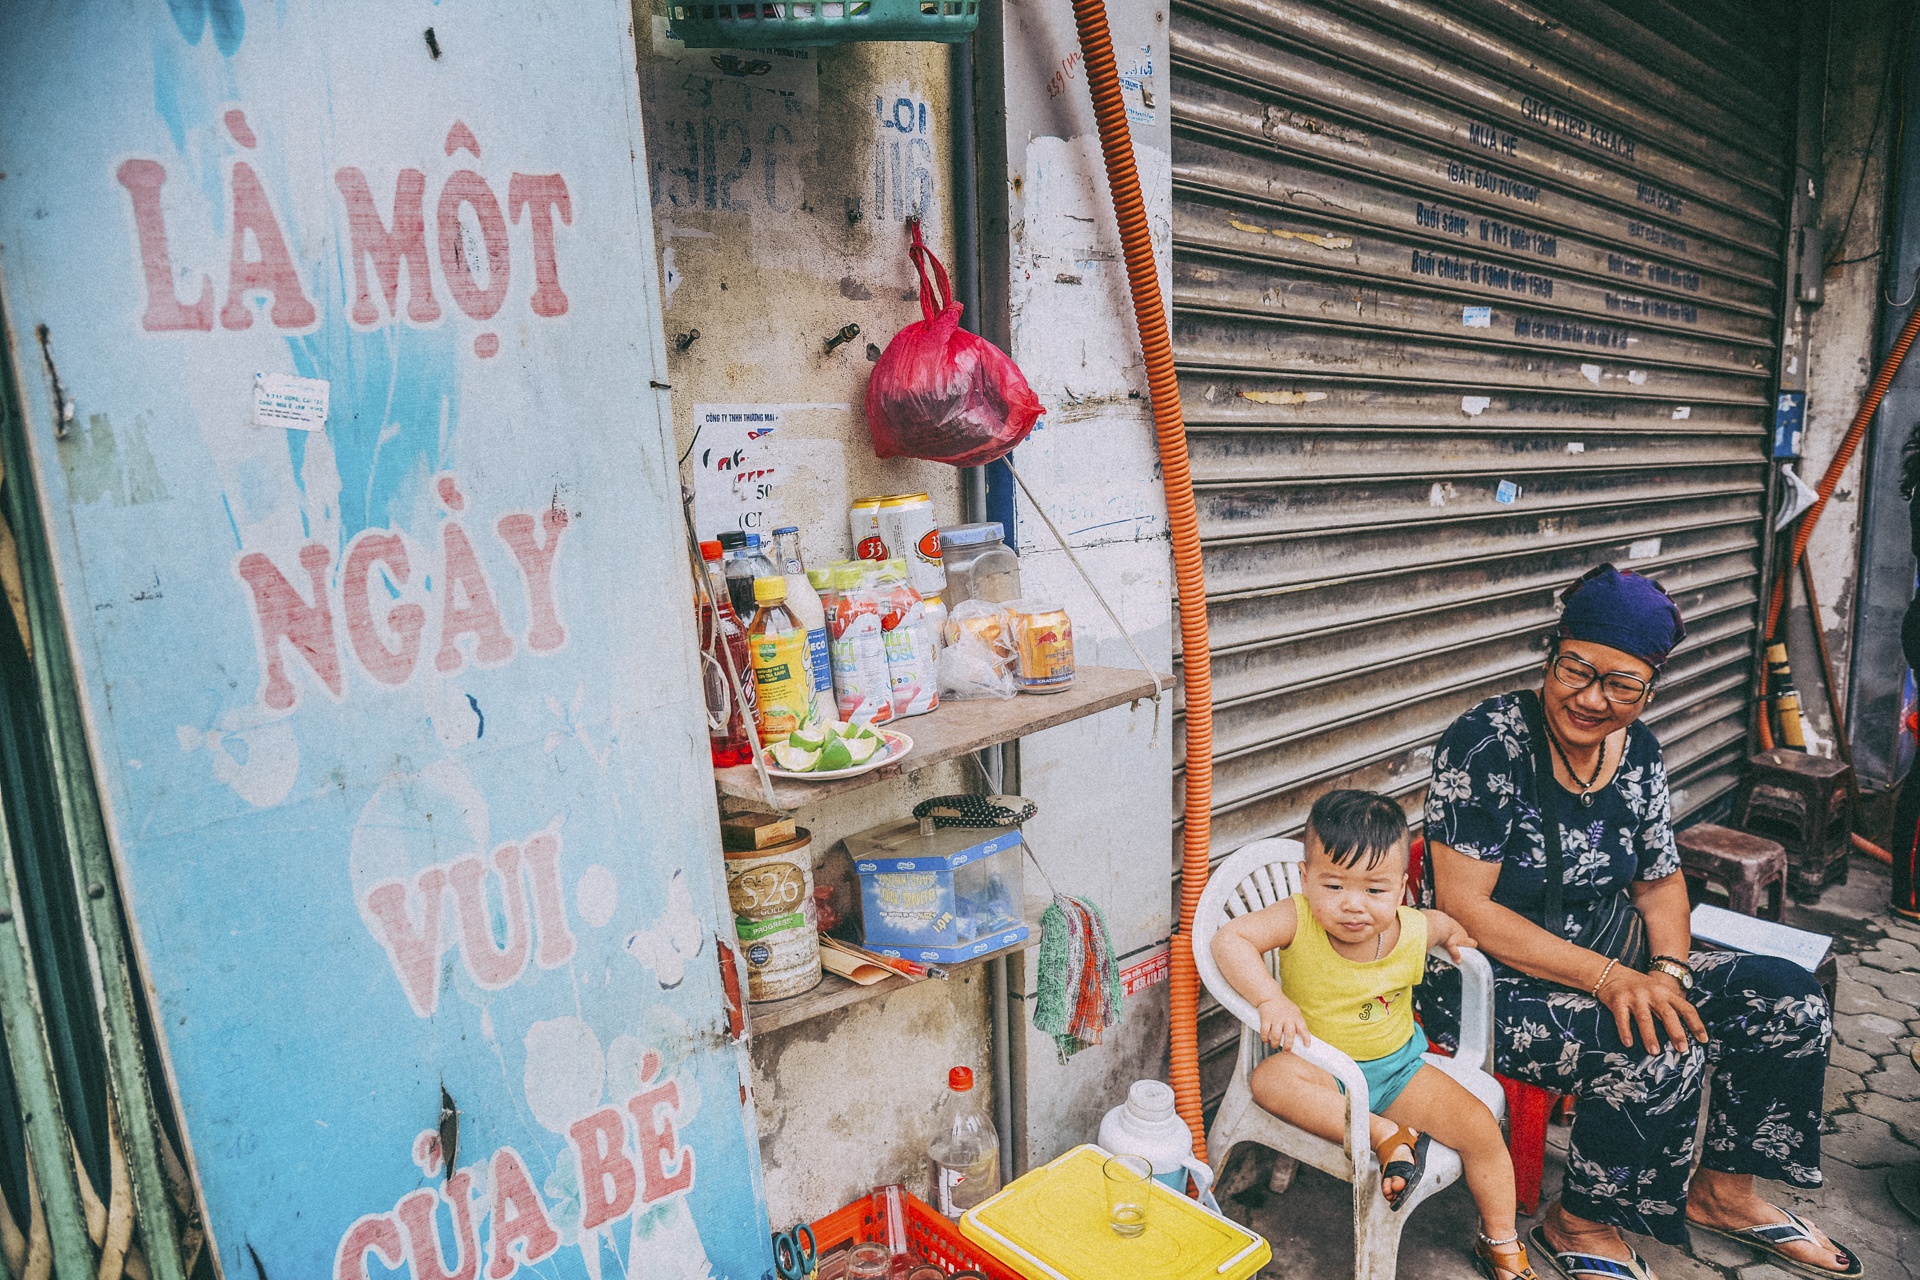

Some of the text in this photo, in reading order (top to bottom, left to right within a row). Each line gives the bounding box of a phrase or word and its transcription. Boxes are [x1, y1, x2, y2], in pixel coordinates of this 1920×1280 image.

[116, 109, 317, 332] LÀ
[334, 119, 573, 359] MỘT
[721, 413, 728, 422] TY
[238, 477, 569, 710] NGÀY
[368, 835, 575, 1012] VUI
[761, 905, 784, 916] GOLD
[1359, 1003, 1373, 1021] 3
[339, 1052, 694, 1280] CỦA BÉ
